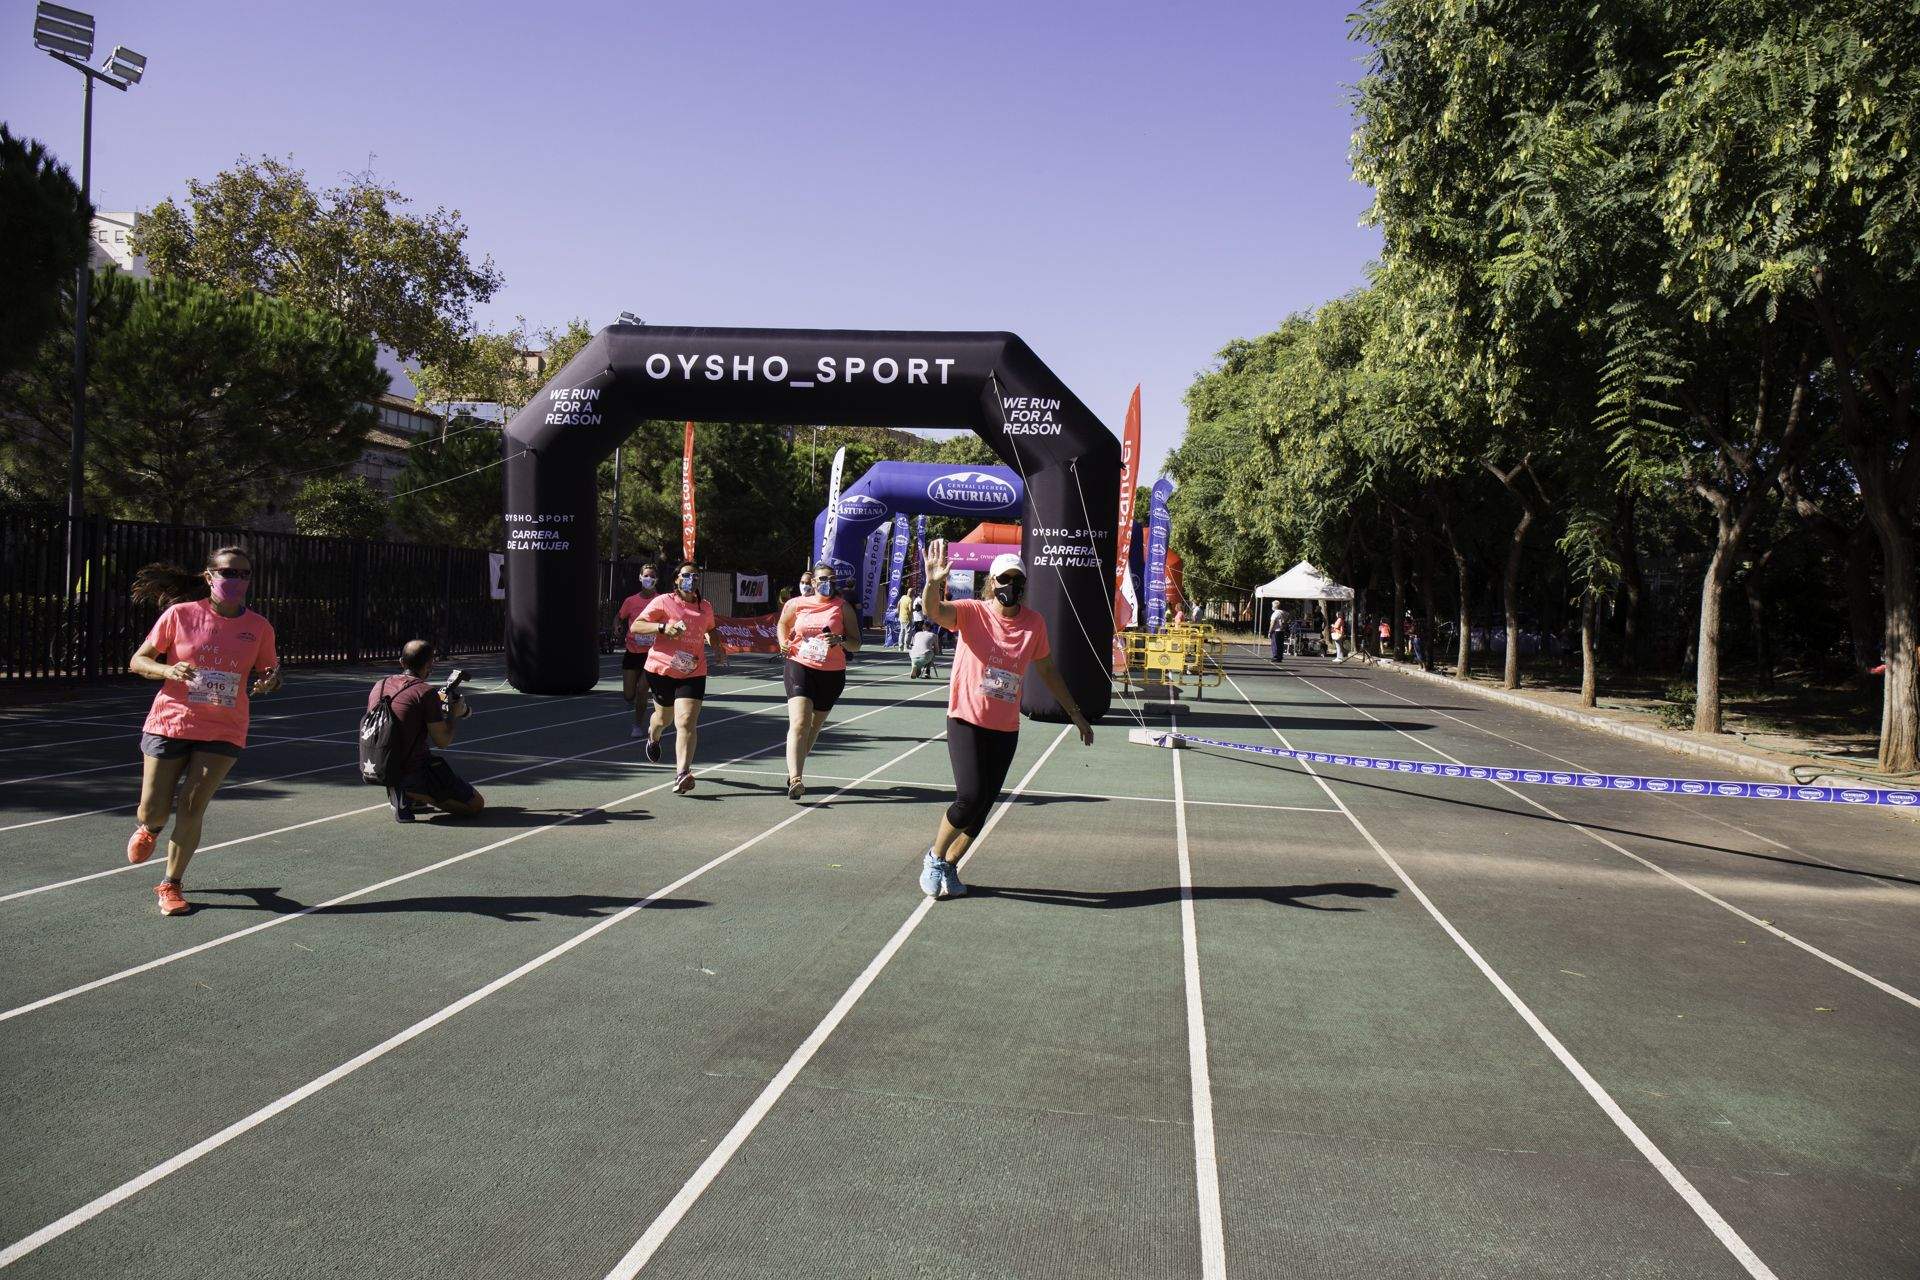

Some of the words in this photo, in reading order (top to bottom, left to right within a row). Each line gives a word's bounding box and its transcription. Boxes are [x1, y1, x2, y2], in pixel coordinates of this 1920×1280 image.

[645, 353, 955, 388] OYSHO_SPORT
[549, 388, 569, 400] WE
[570, 388, 601, 400] RUN
[553, 400, 581, 413] FOR
[582, 401, 593, 413] A
[1003, 397, 1028, 409] WE
[1029, 397, 1061, 410] RUN
[544, 413, 602, 425] REASON
[1010, 410, 1041, 422] FOR
[1042, 410, 1053, 422] A
[1002, 423, 1062, 435] REASON
[934, 483, 1010, 503] ASTURIANA
[837, 504, 884, 515] ASTURIANA
[505, 514, 575, 524] OYSHO_SPORT
[512, 530, 560, 539] CARRERA
[1032, 528, 1109, 539] OYSHO_SPORT
[507, 540, 517, 550] DE
[518, 540, 529, 550] LA
[531, 541, 570, 551] MUJER
[1042, 545, 1095, 556] CARRERA
[1034, 556, 1048, 566] DE
[1049, 556, 1063, 566] LA
[1065, 557, 1103, 567] MUJER
[206, 681, 226, 691] 016
